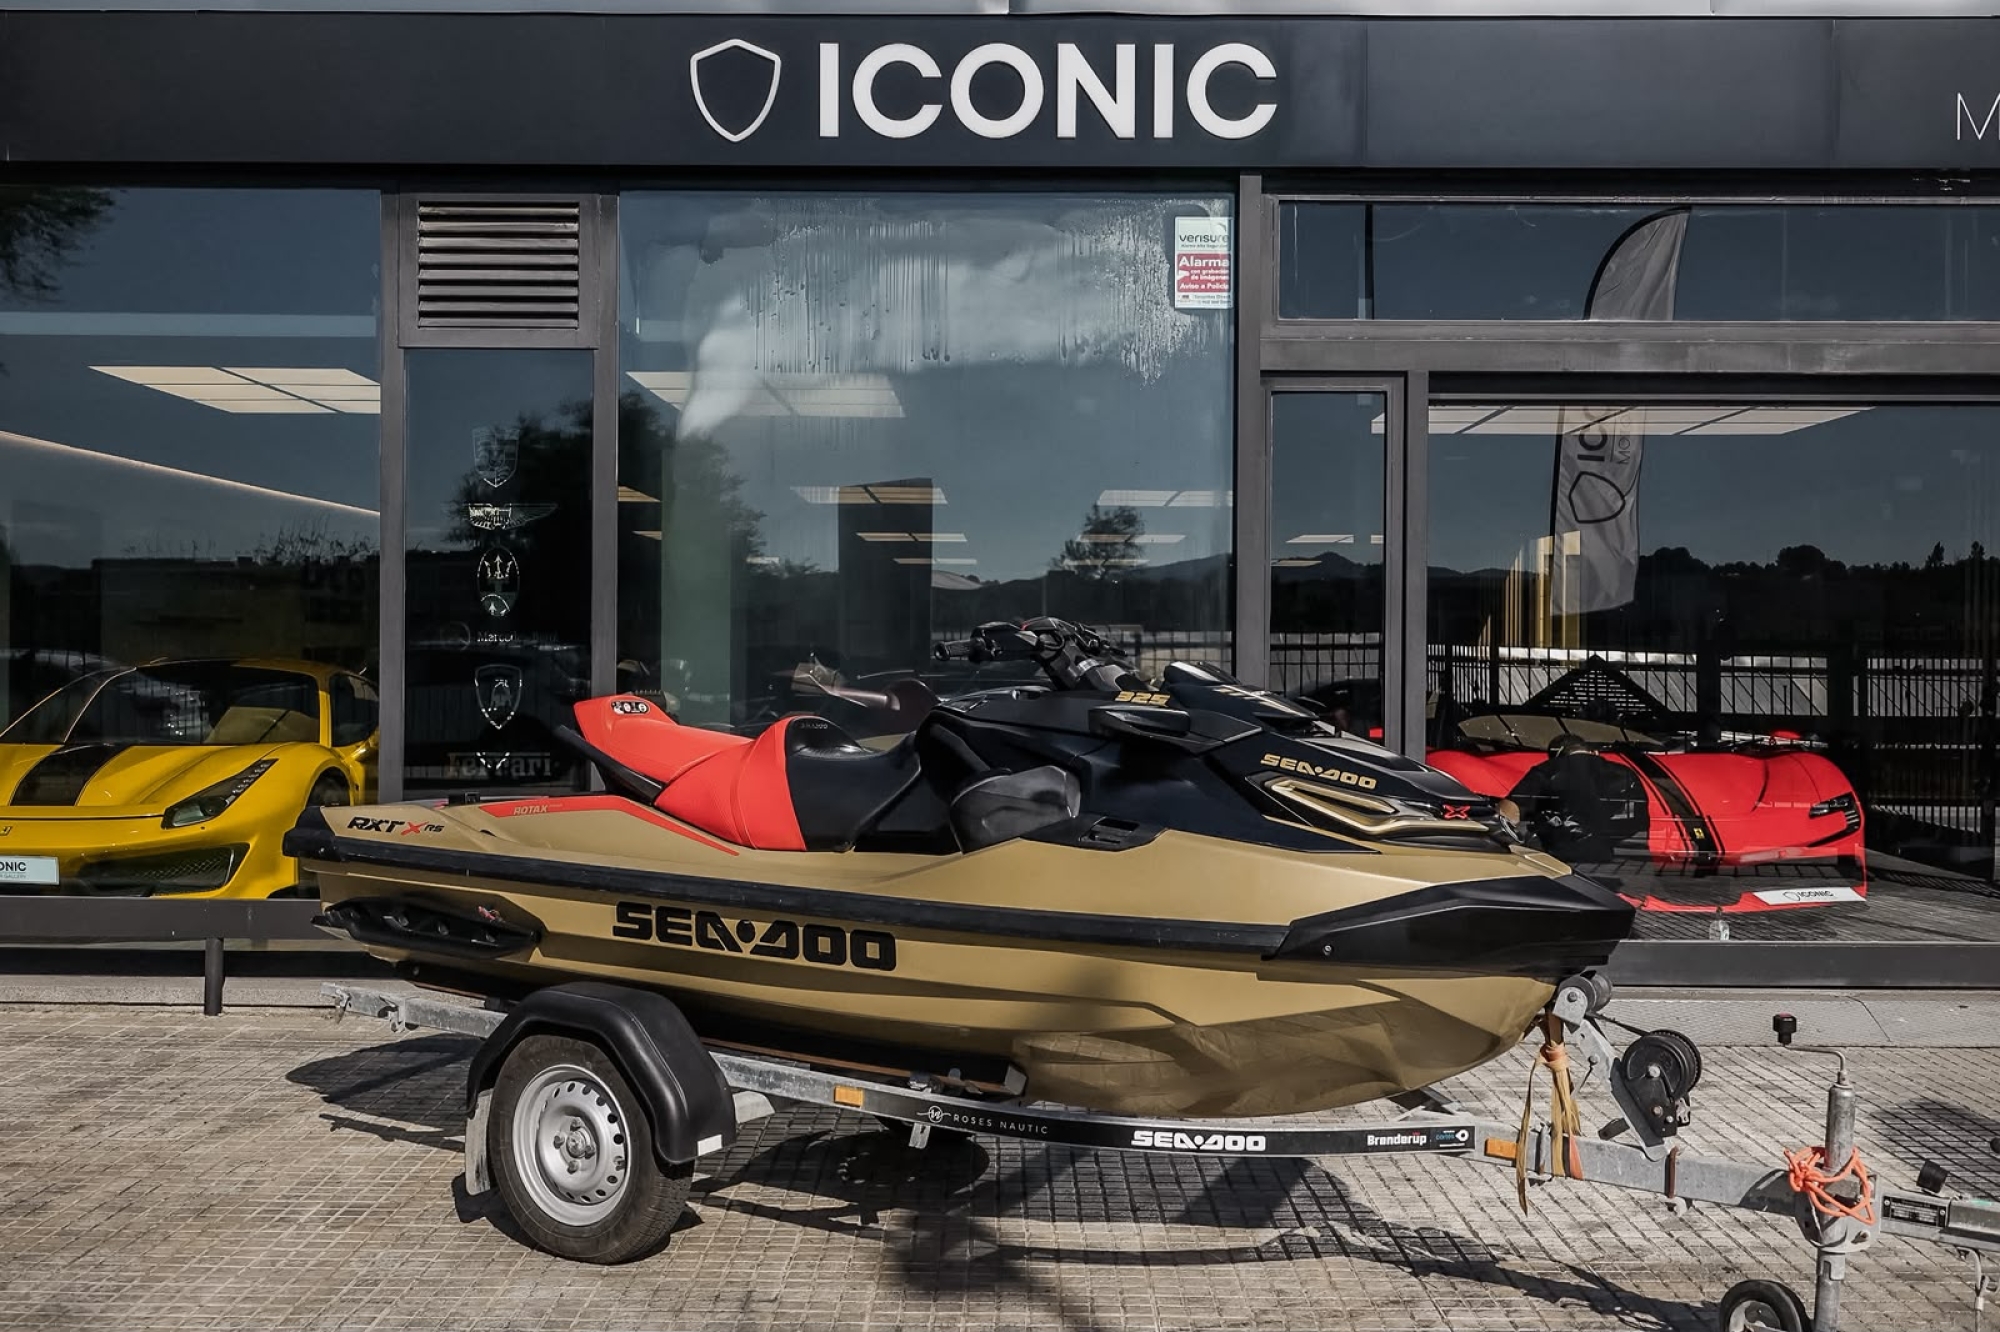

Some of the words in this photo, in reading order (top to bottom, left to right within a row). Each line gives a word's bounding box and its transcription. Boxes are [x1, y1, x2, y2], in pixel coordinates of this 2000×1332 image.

[819, 42, 1278, 139] ICONIC
[1179, 255, 1230, 267] Alarma
[1114, 690, 1171, 708] 325
[513, 804, 549, 816] ROTAX
[347, 816, 405, 833] RXT
[424, 824, 445, 833] RS
[953, 1113, 992, 1127] ROSES
[999, 1121, 1048, 1134] NAUTIC
[1367, 1132, 1427, 1146] Brenderup
